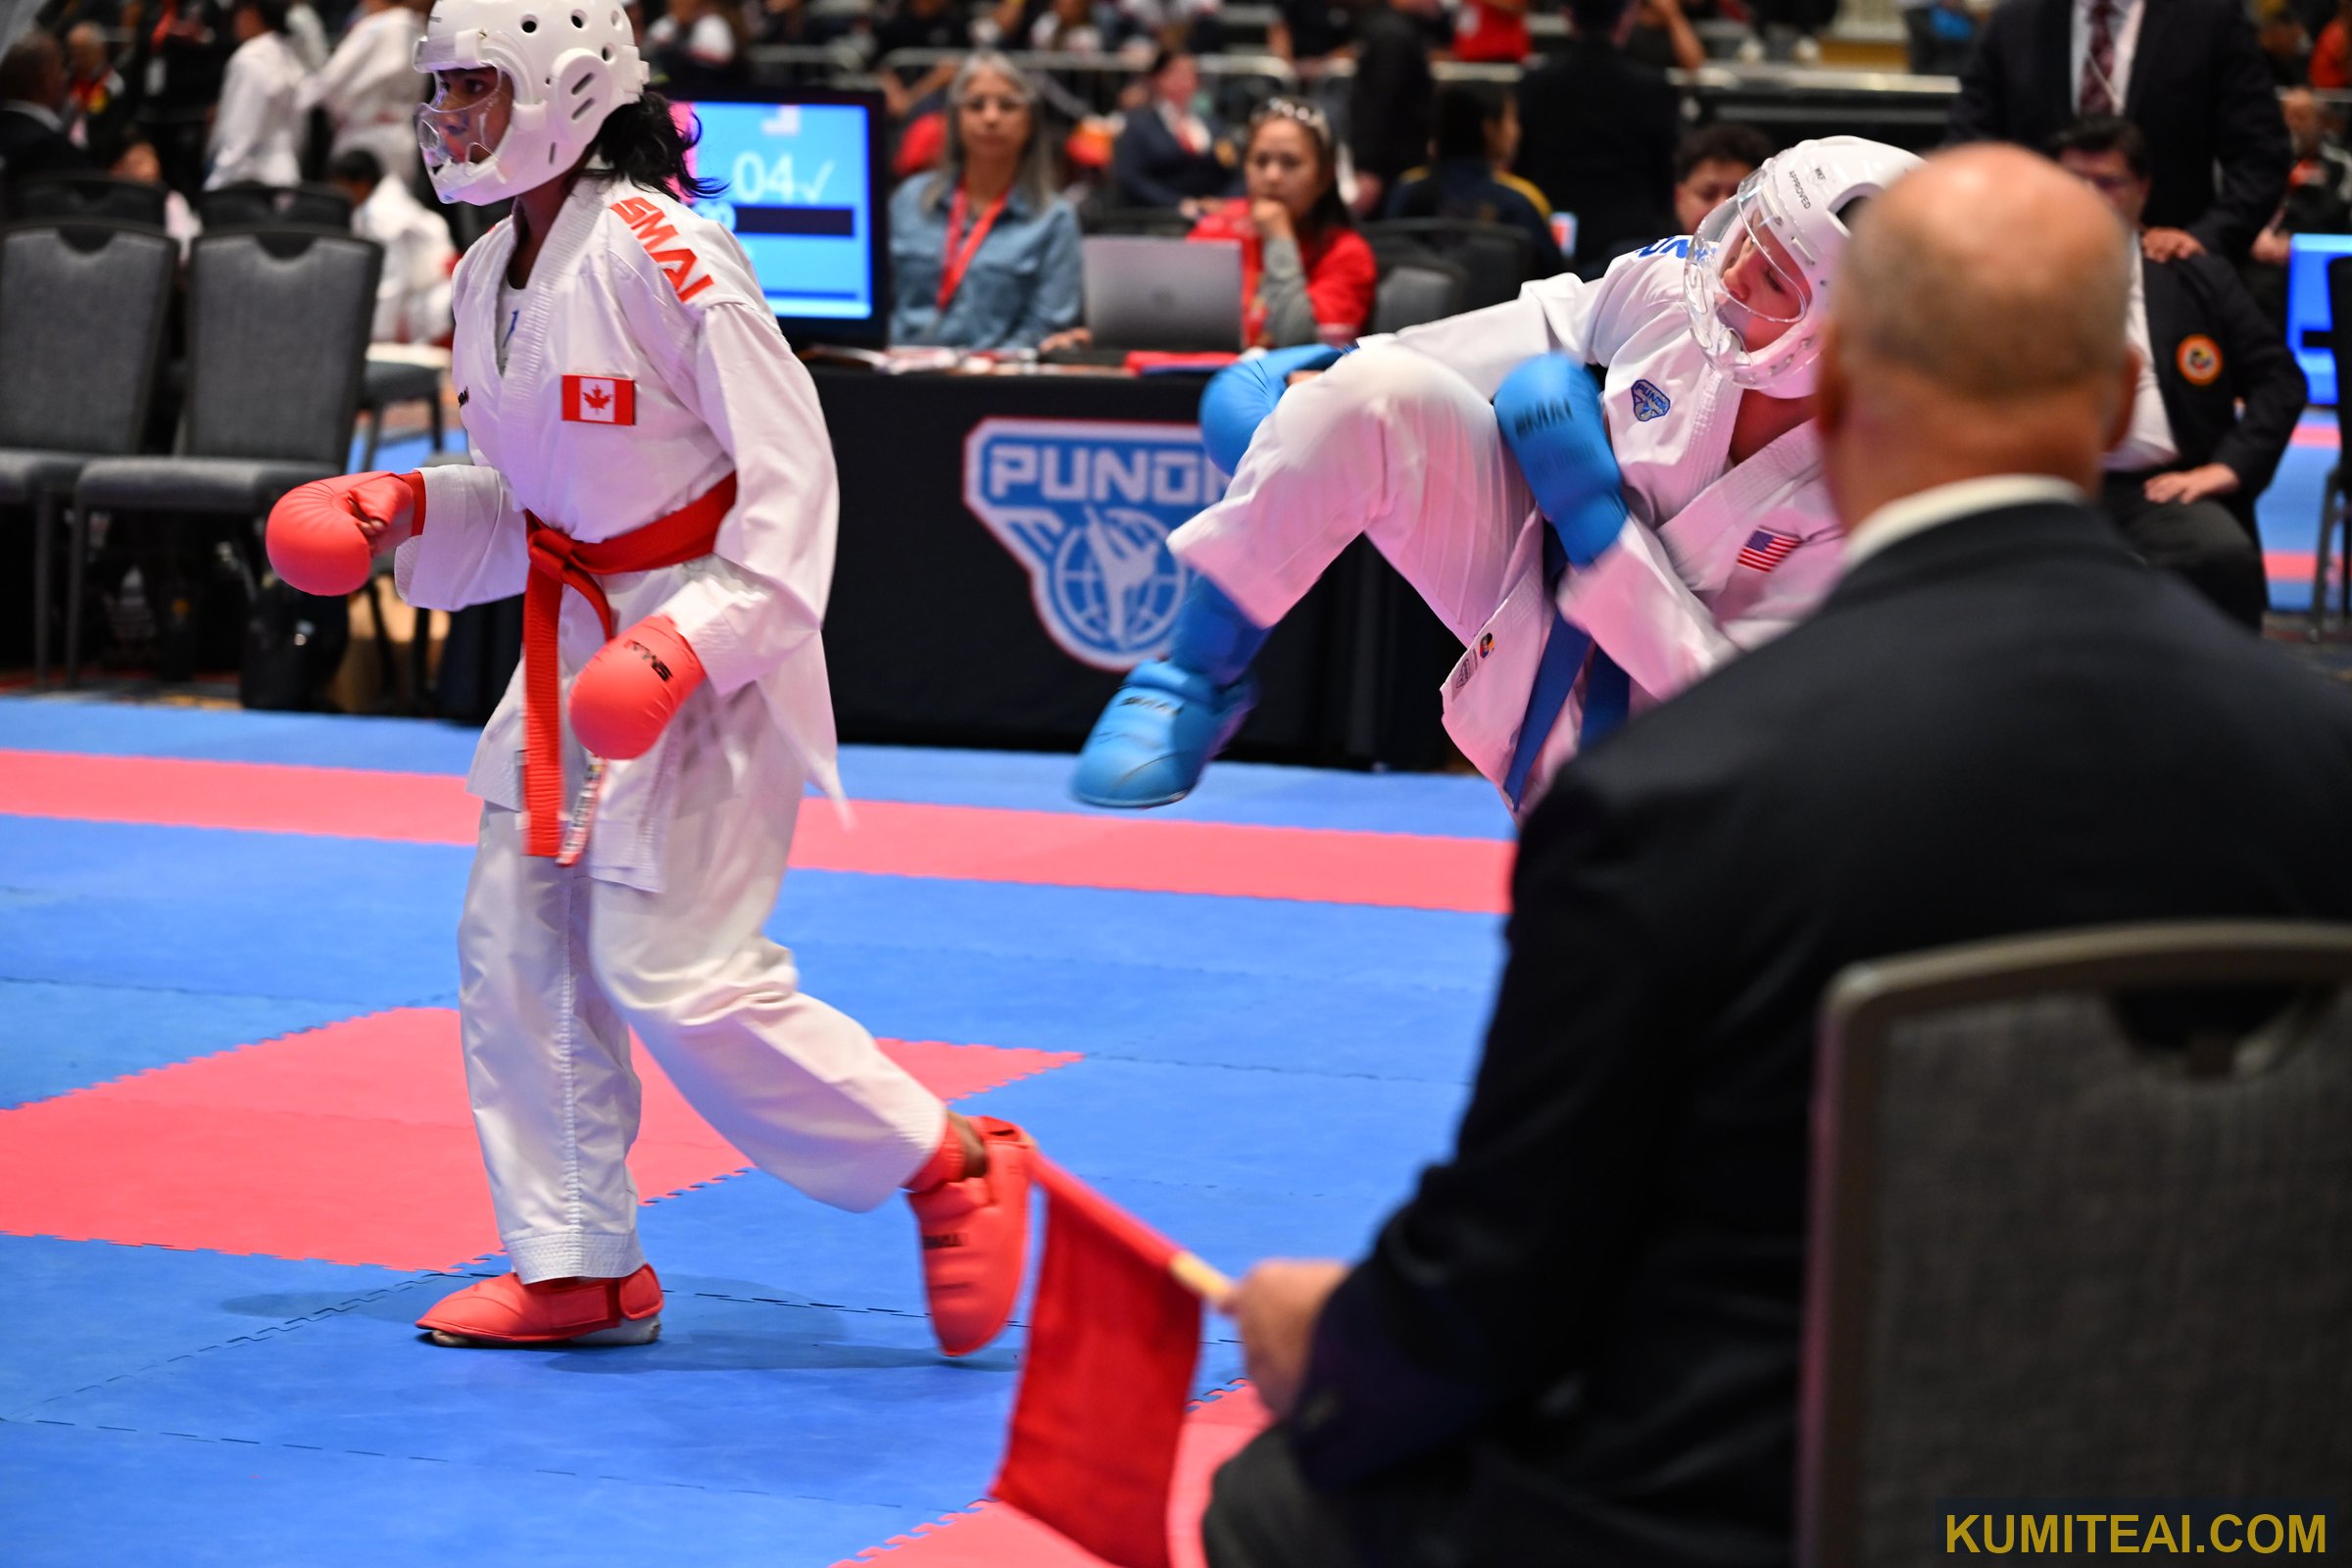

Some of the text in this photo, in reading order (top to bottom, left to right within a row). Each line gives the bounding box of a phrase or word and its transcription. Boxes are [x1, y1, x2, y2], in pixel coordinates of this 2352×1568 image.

[733, 151, 795, 204] 04
[1788, 171, 1812, 211] APPROVED
[608, 196, 715, 304] SMAI
